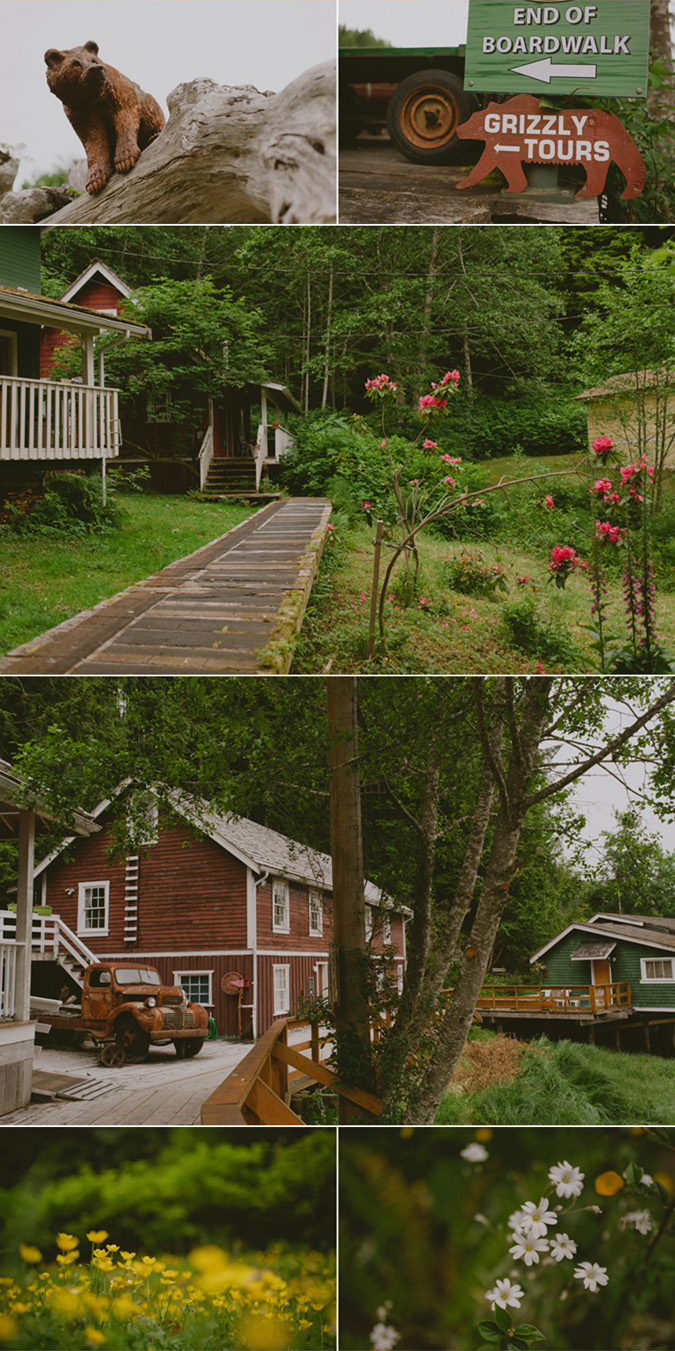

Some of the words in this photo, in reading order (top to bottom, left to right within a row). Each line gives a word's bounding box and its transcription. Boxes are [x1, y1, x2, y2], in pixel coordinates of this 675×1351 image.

[513, 7, 560, 25] END
[565, 6, 598, 24] OF
[482, 35, 632, 55] BOARDWALK
[484, 113, 588, 136] GRIZZLY
[524, 138, 610, 161] TOURS
